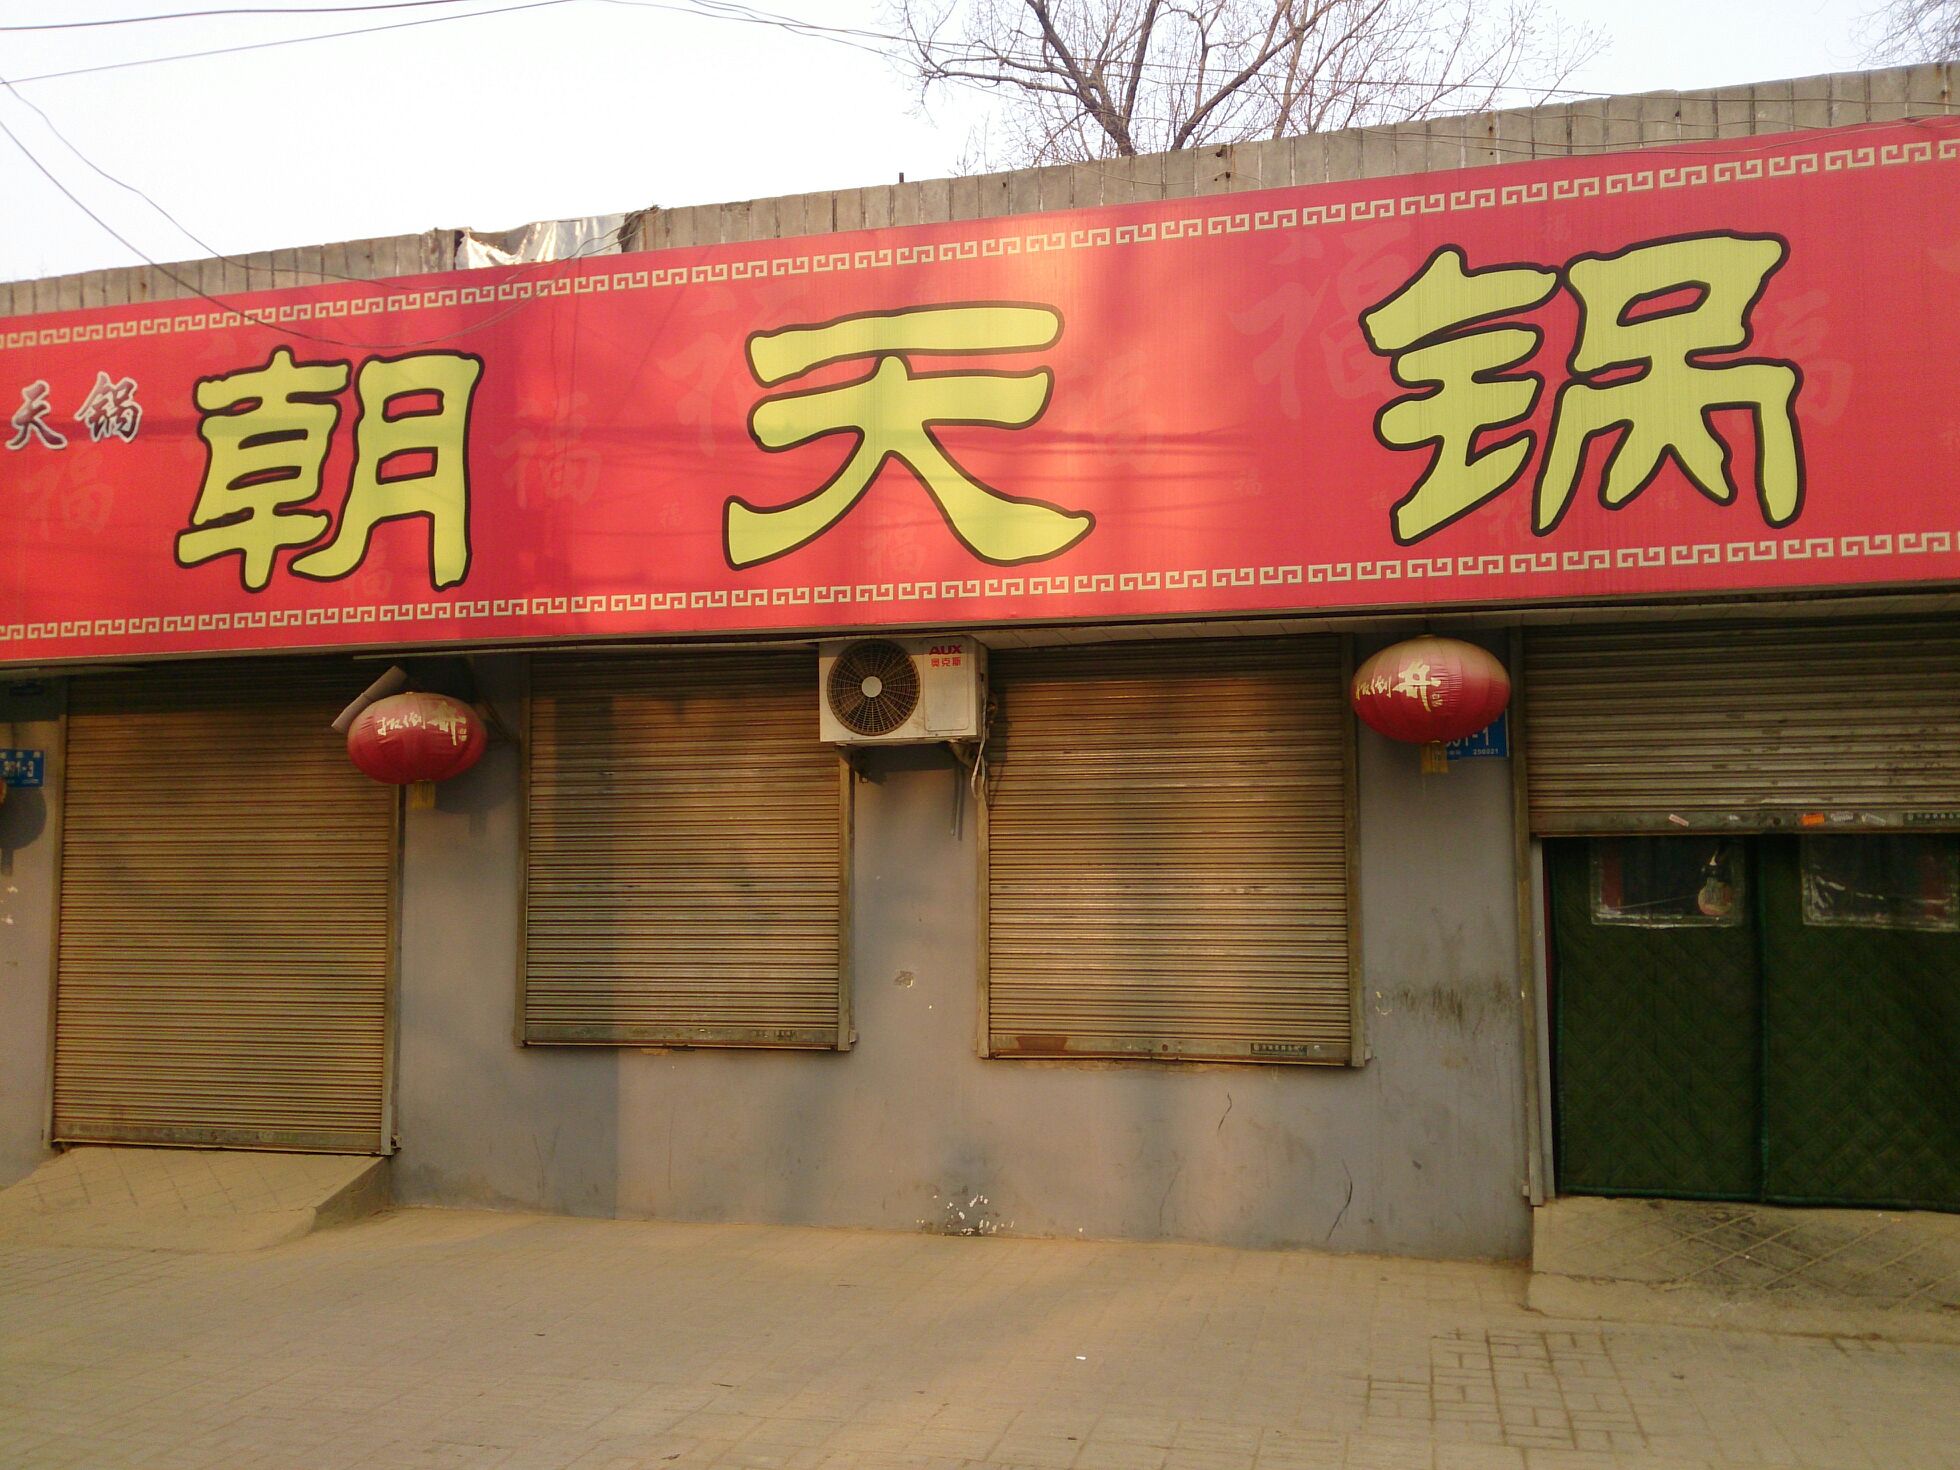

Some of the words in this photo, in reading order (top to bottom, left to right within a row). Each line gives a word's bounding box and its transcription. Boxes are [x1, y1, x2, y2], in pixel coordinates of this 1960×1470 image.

[174, 230, 1806, 592] 朝天锅
[929, 645, 961, 655] AUX
[931, 657, 961, 667] 奥克斯
